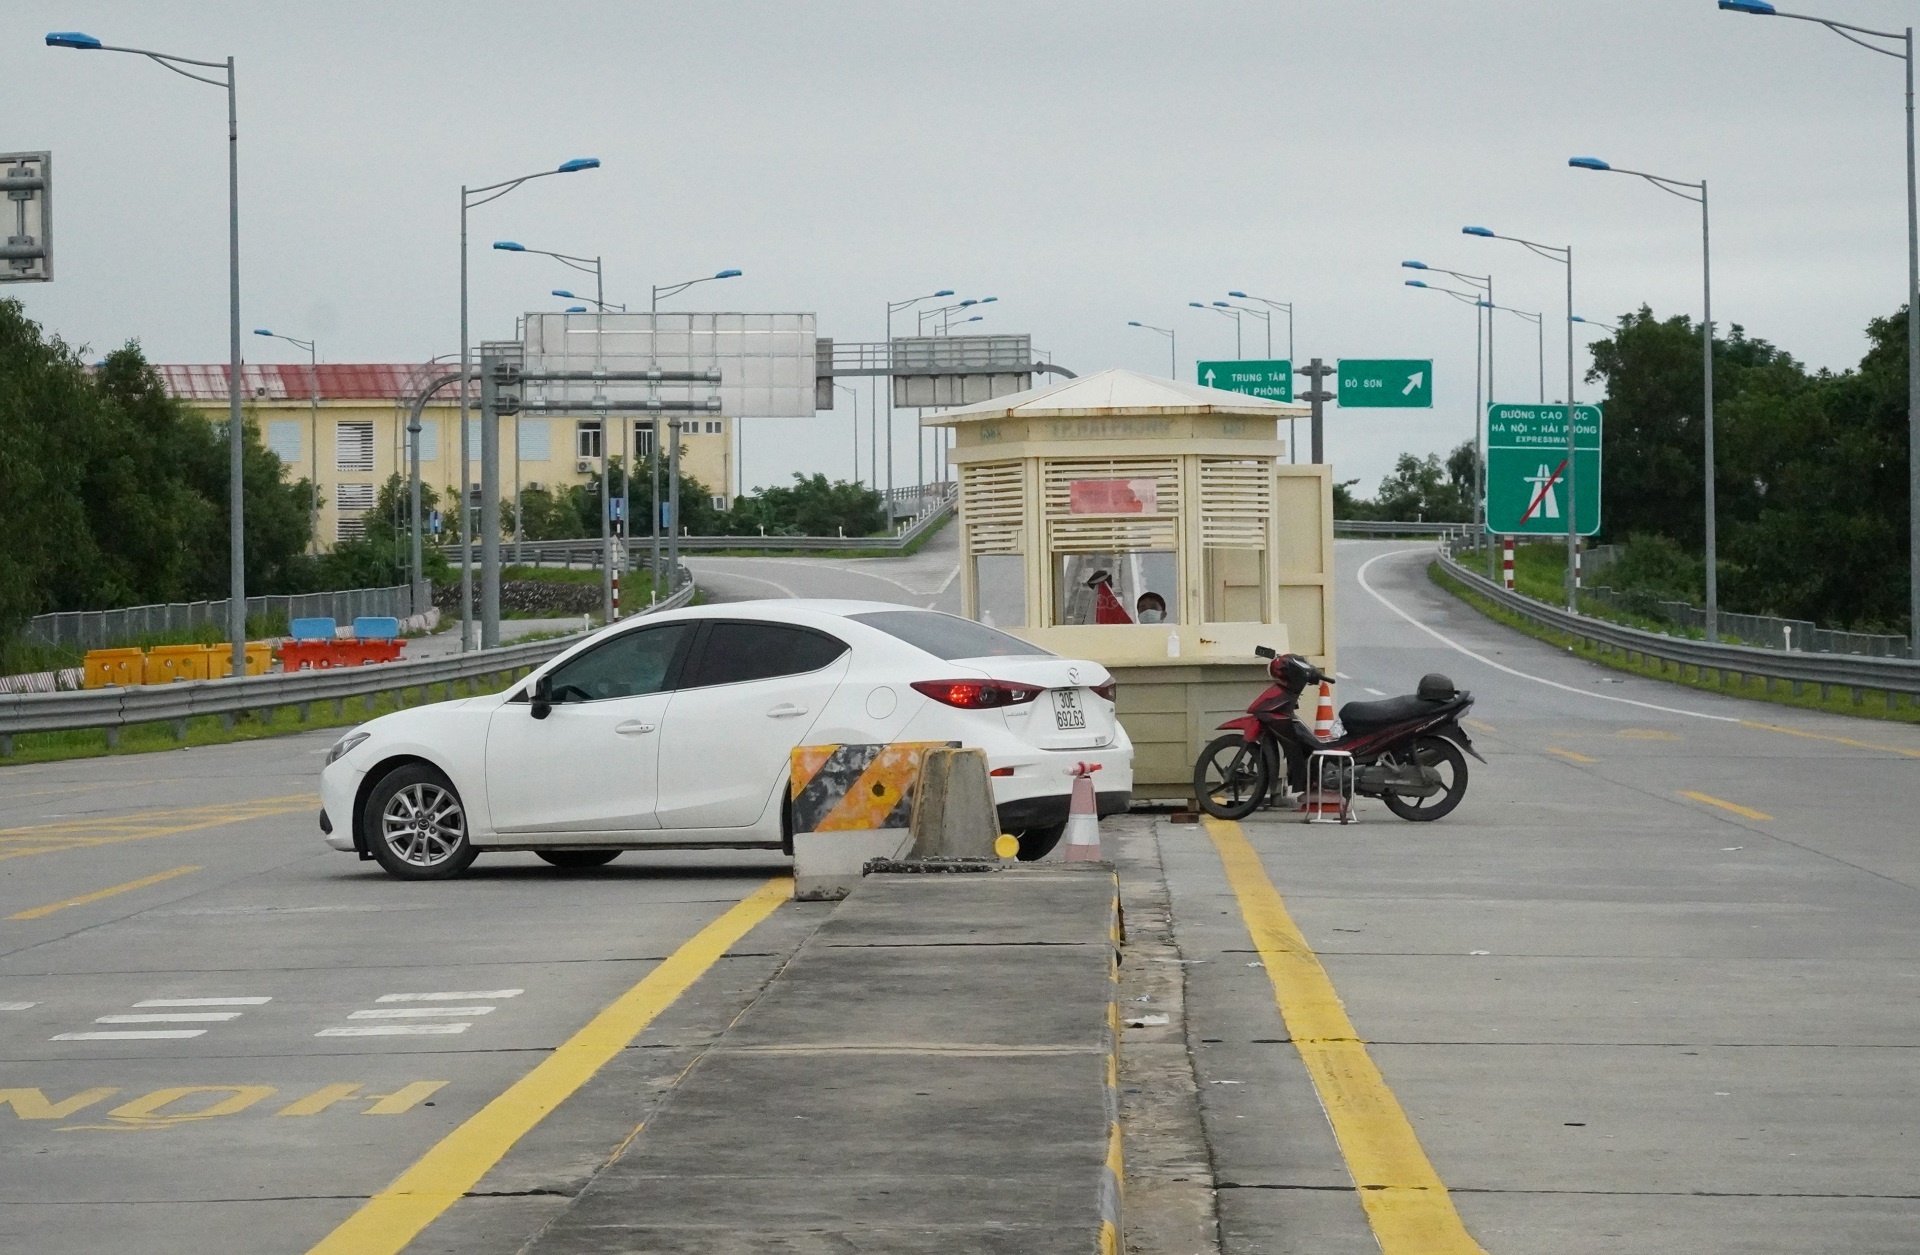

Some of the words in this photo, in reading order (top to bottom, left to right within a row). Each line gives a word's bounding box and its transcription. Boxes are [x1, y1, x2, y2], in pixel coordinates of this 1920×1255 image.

[1231, 373, 1262, 382] TRUNG
[1253, 385, 1286, 396] PHÒNG
[1501, 409, 1535, 419] ĐƯỜNG
[1540, 412, 1562, 420] CAO
[1491, 422, 1505, 432] HÀ
[1511, 423, 1527, 434] NỘI
[1541, 423, 1558, 433] HẢI
[1058, 692, 1076, 709] 30E
[1056, 709, 1085, 727] 692.63
